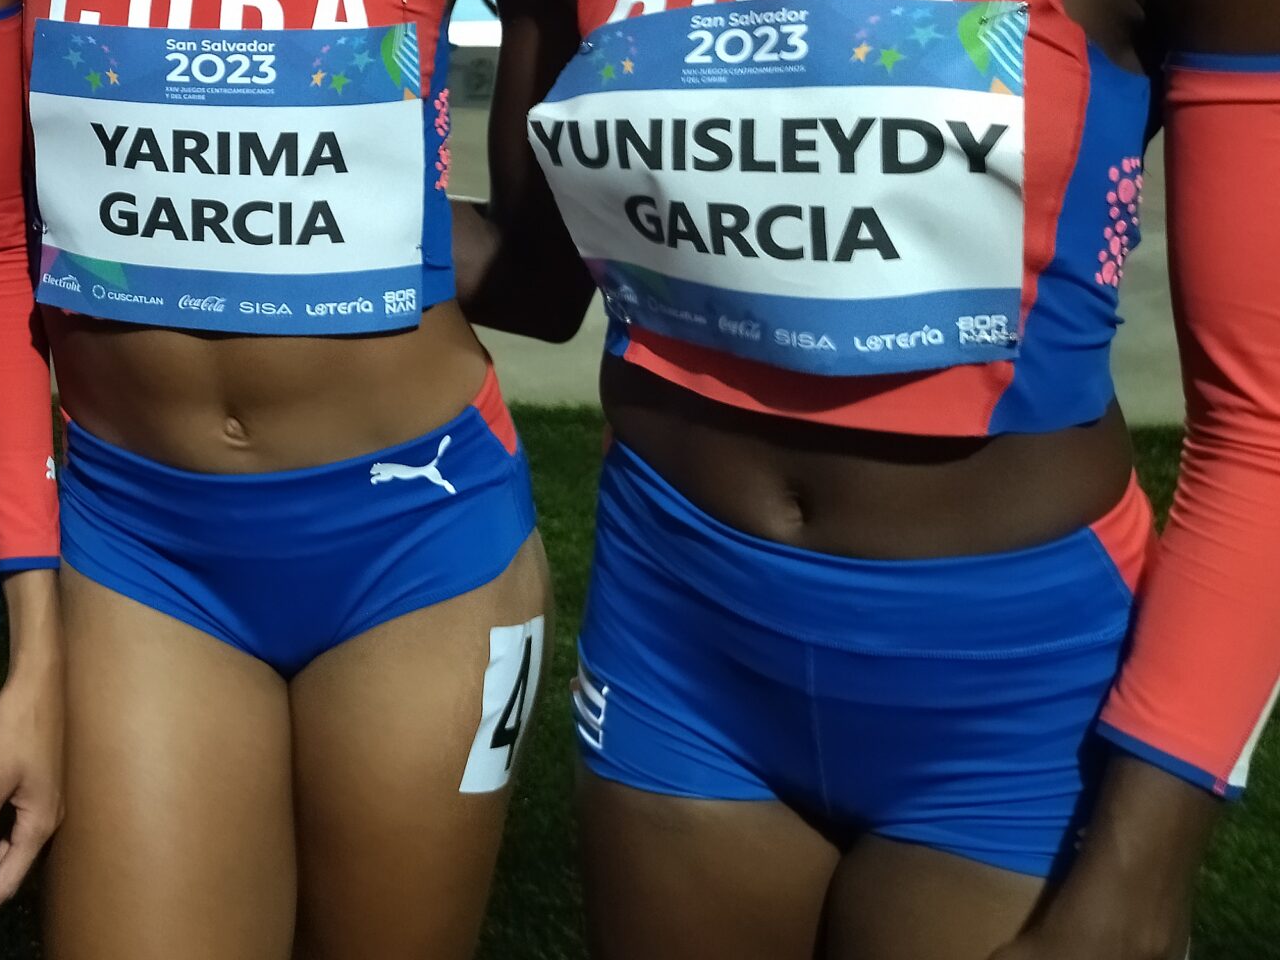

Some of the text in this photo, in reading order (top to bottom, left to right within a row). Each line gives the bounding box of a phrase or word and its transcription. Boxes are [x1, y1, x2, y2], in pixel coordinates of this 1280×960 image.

[690, 7, 809, 29] San Salvador
[166, 38, 275, 52] San Salvador
[684, 24, 808, 63] 2023
[164, 52, 277, 85] 2023
[90, 121, 349, 177] YARIMA
[530, 116, 1010, 174] YUNISLEYDY
[99, 191, 345, 246] GARCIA
[624, 195, 900, 263] GARCIA
[107, 292, 164, 305] CUSCATLAN
[239, 301, 292, 315] SISA
[383, 288, 416, 303] BOR
[385, 299, 416, 314] NAN
[956, 315, 1008, 330] BOR
[773, 328, 837, 352] SISA
[490, 636, 532, 771] 4
